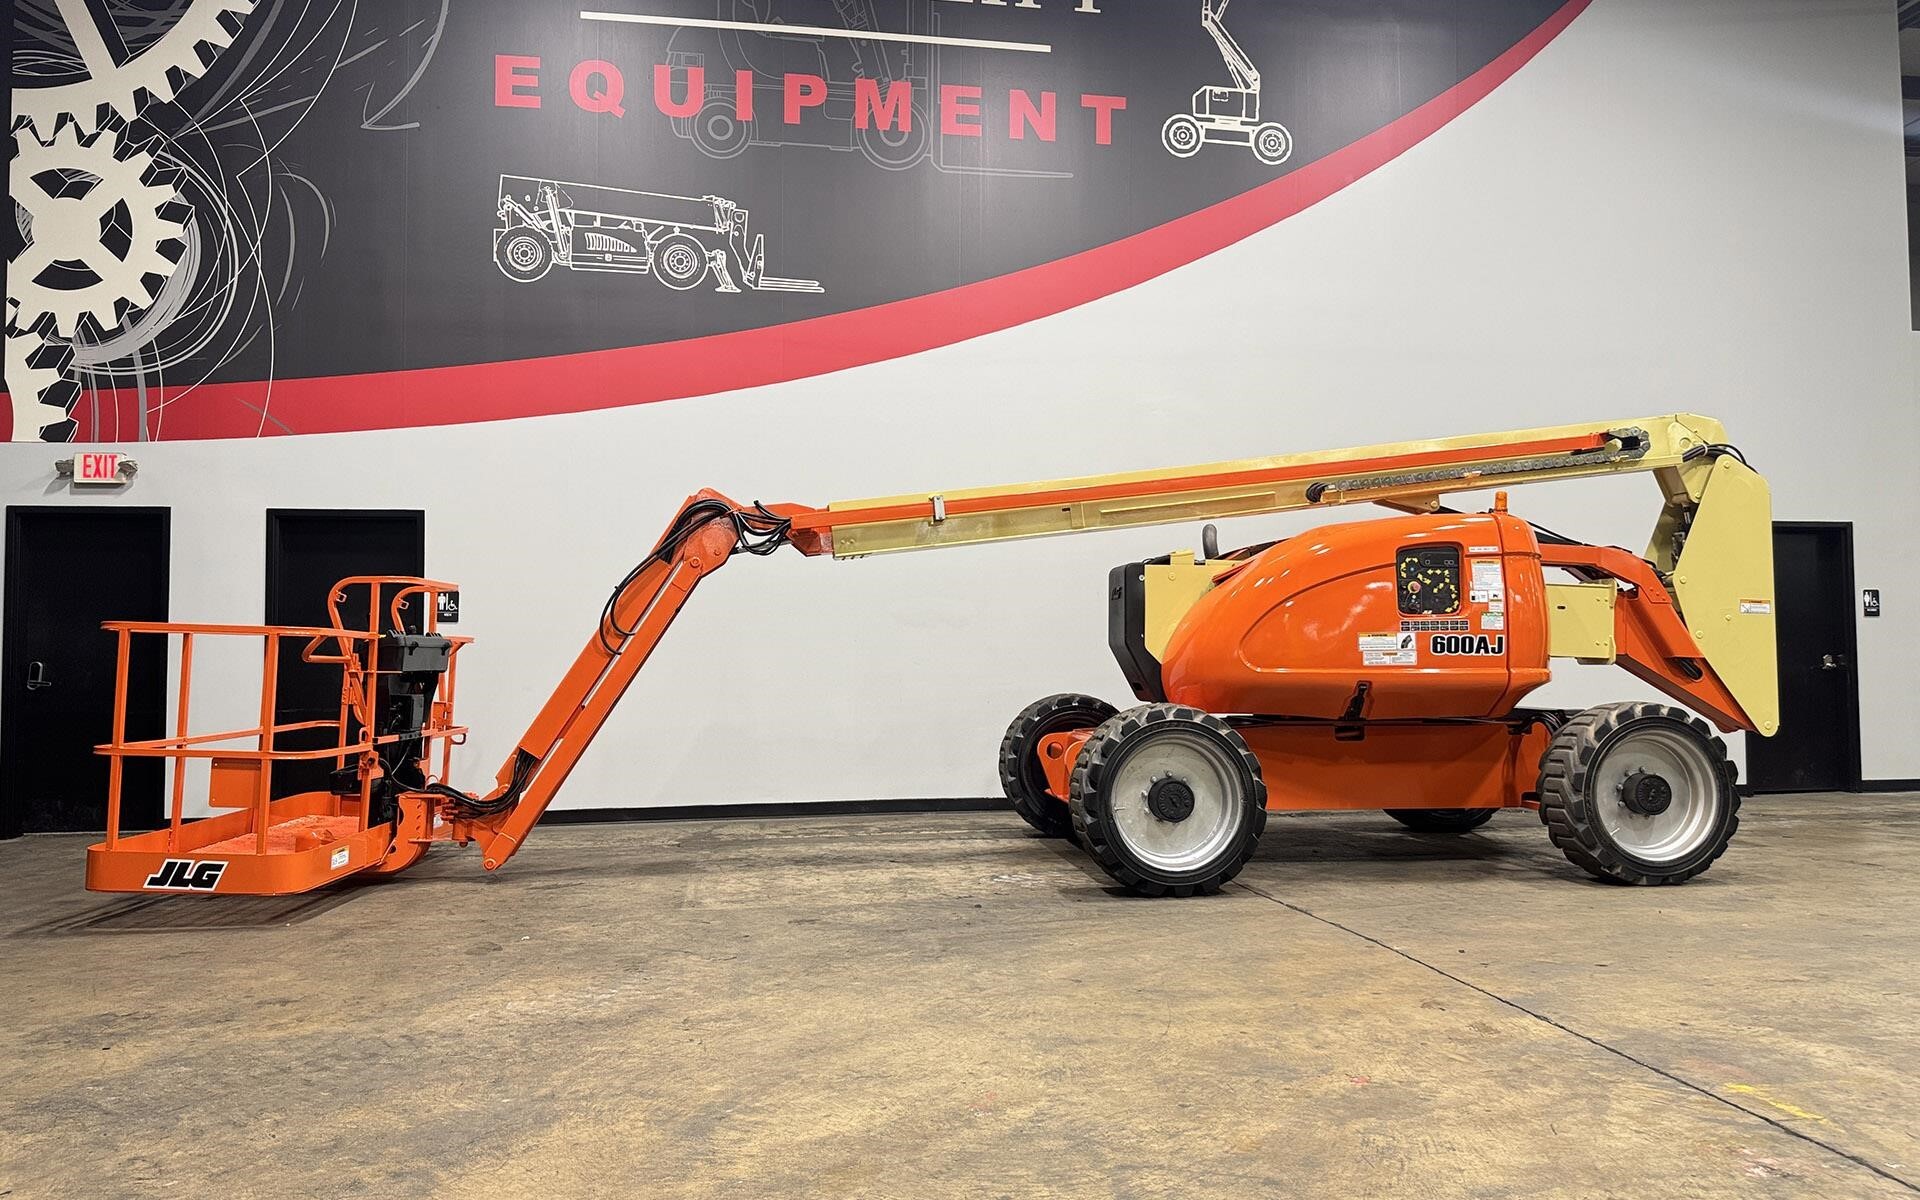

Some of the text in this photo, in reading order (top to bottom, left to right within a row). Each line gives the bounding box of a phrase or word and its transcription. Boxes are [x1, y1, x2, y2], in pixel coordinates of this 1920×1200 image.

[495, 54, 1127, 145] EQUIPMENT
[82, 454, 118, 479] EXIT
[1431, 635, 1504, 655] 600AJ
[145, 860, 226, 889] JLG
